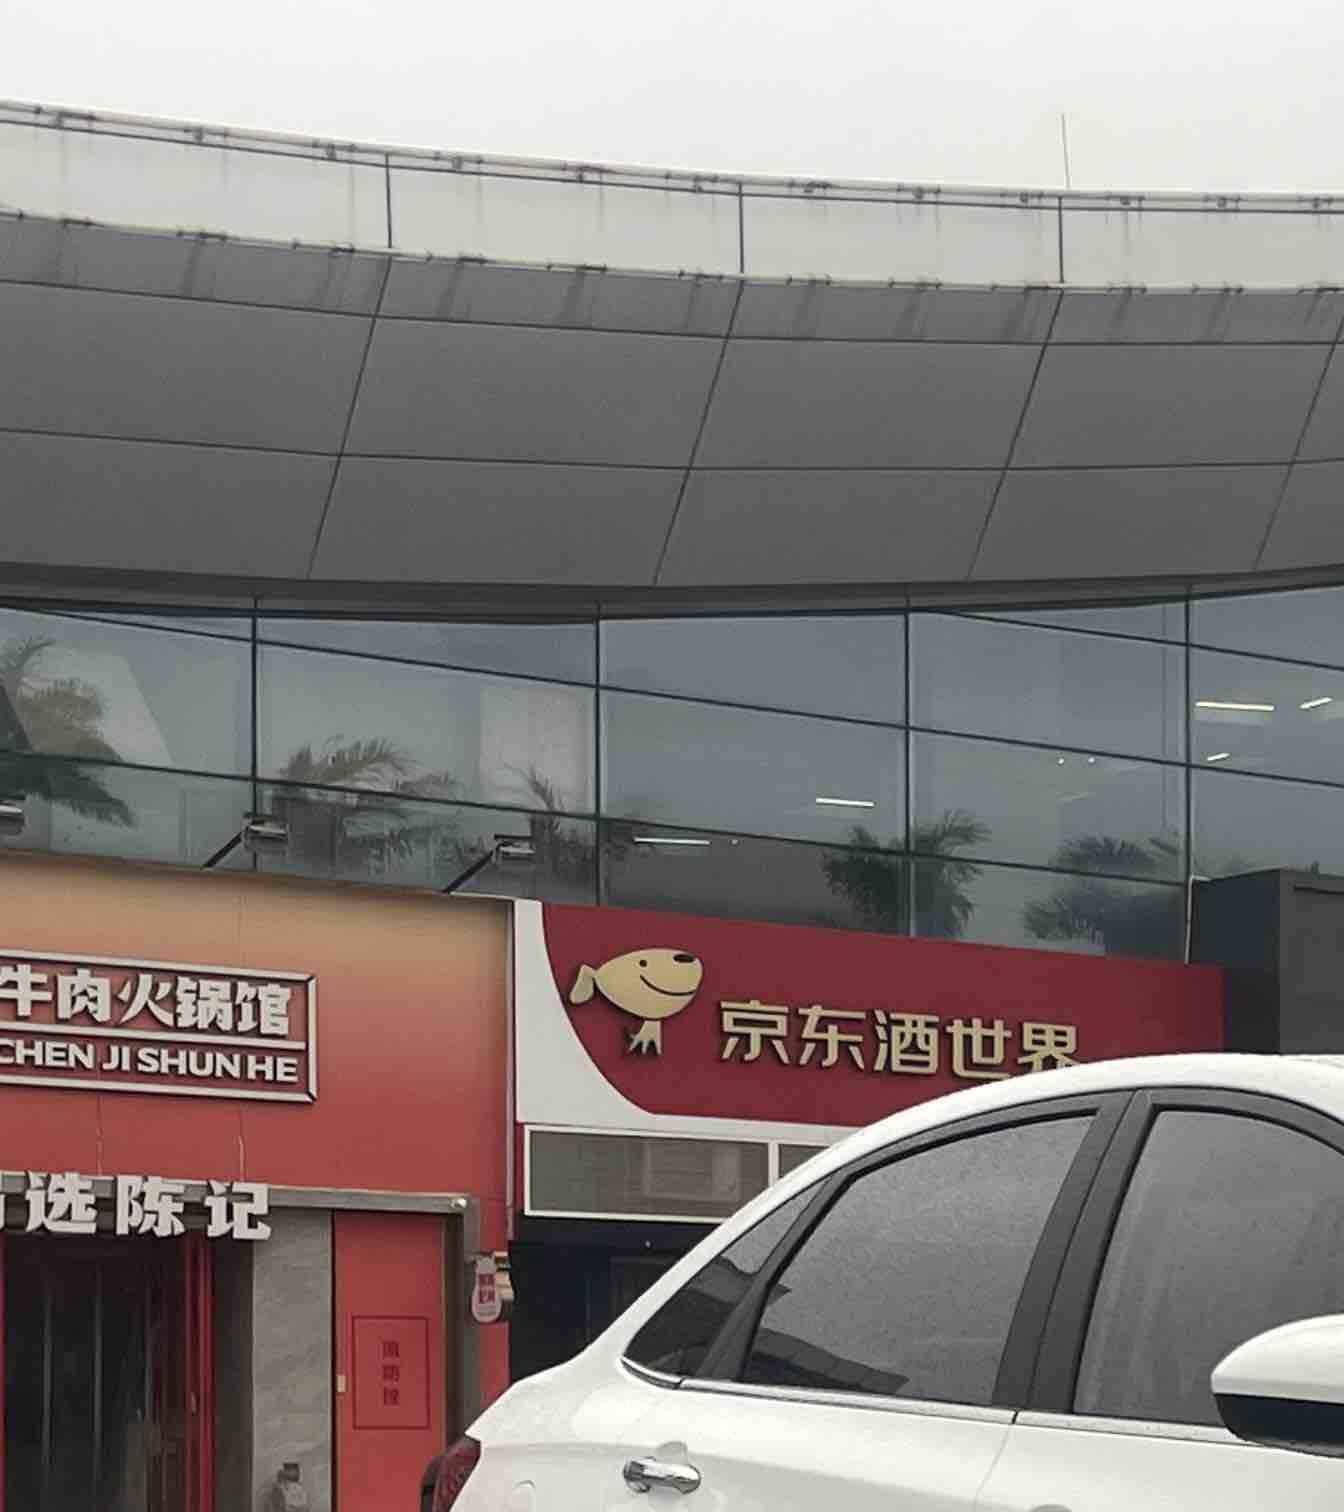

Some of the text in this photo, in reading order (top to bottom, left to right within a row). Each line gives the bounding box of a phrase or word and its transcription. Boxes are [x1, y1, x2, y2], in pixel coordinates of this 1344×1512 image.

[0, 964, 291, 1037] 牛肉火锅馆
[0, 1038, 299, 1083] CHEN JI SHUN HE
[719, 999, 1080, 1081] 京东酒世界
[0, 1170, 272, 1240] 选陈记
